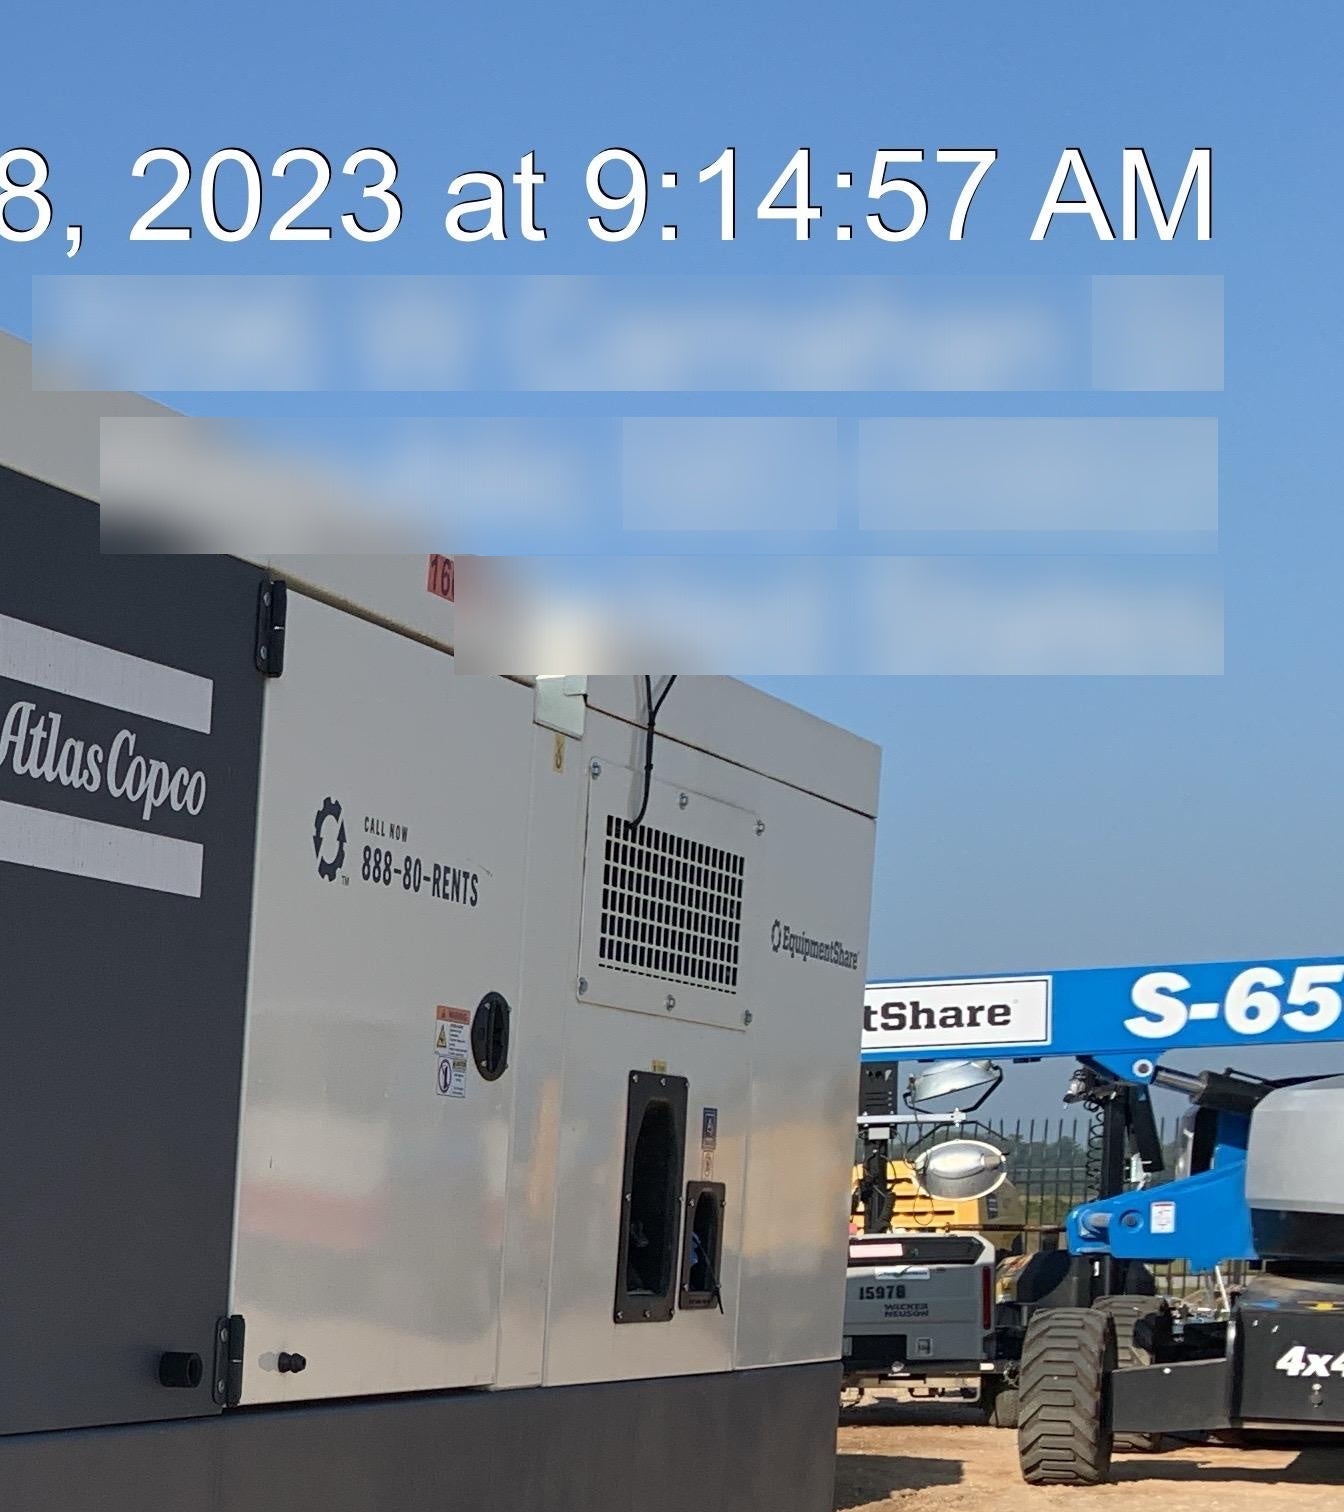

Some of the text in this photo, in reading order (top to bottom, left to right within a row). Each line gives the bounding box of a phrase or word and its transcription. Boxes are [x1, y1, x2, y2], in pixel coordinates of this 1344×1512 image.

[107, 729, 206, 821] Copco
[364, 816, 409, 843] CALL NOW
[362, 845, 479, 907] 888-80-RENTS
[783, 925, 858, 970] EquipmentShare
[1123, 966, 1344, 1039] S-65
